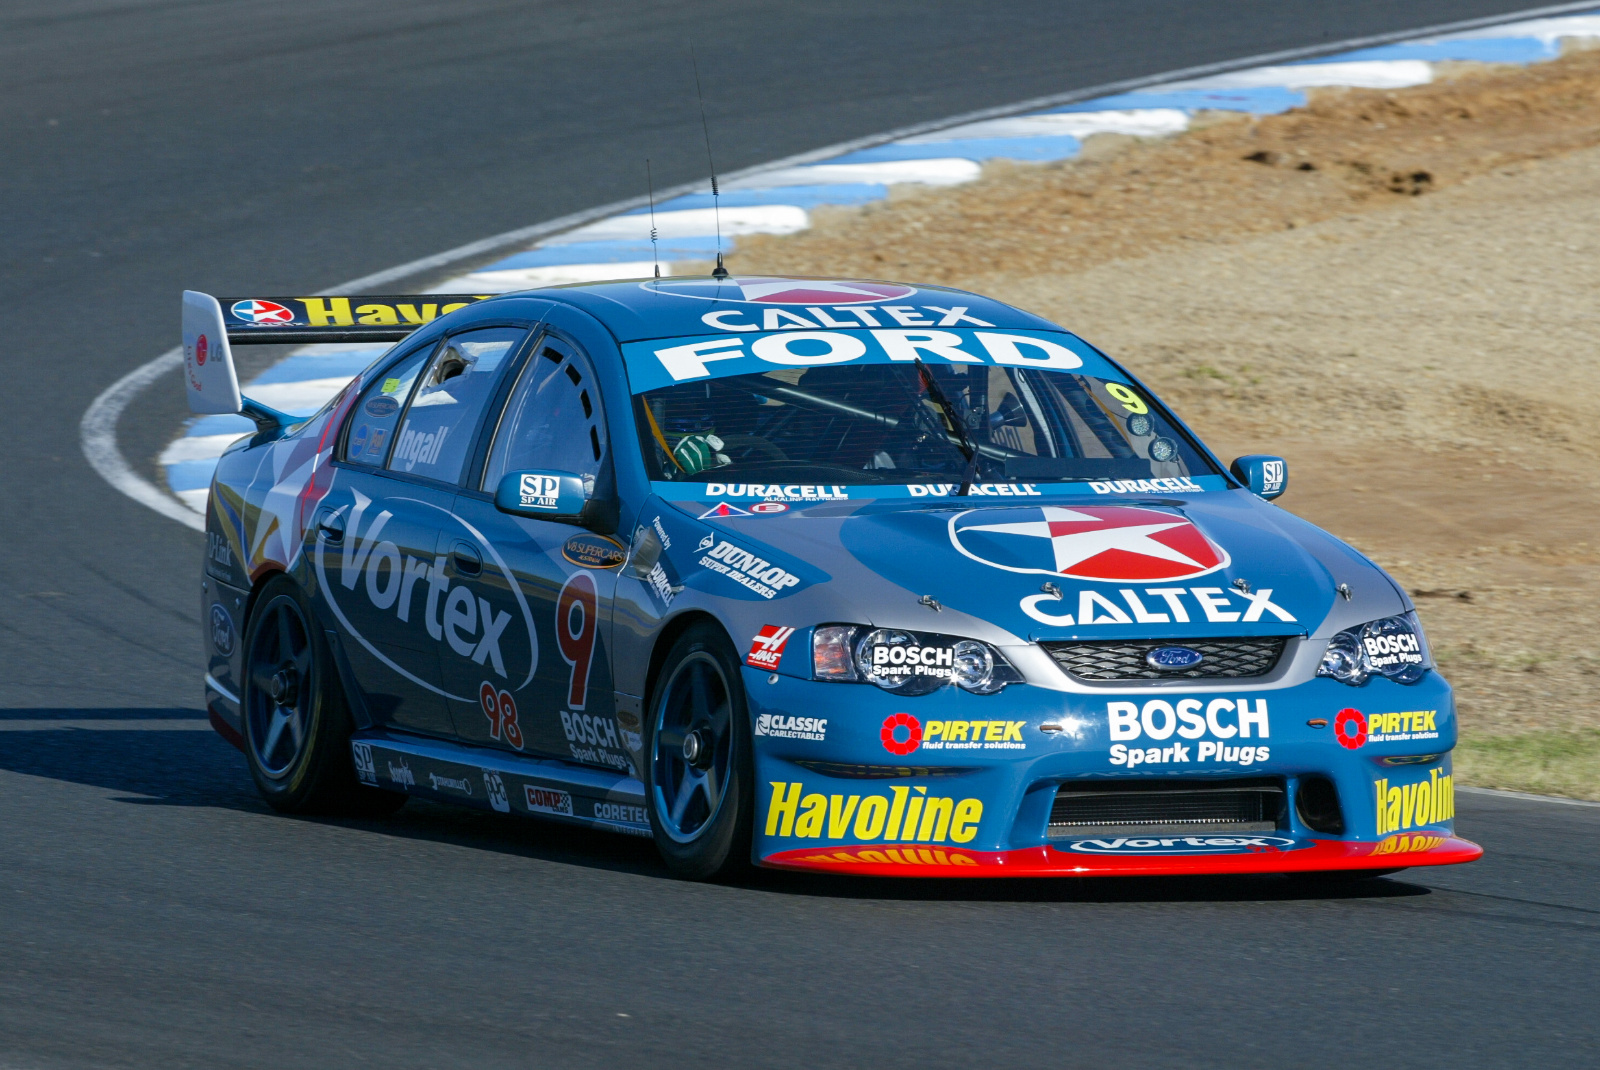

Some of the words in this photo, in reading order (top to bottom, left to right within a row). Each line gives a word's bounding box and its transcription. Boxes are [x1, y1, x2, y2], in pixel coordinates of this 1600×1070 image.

[701, 305, 996, 331] CALTEX
[653, 329, 1083, 381] FORD
[1105, 383, 1148, 414] 9
[394, 419, 449, 472] Ingall
[1265, 463, 1282, 482] SP
[521, 476, 557, 496] SP
[705, 483, 849, 498] DURACELL
[1088, 477, 1200, 495] DURACELL
[521, 496, 535, 504] SP
[537, 497, 556, 506] AIR
[652, 515, 669, 541] Powered
[567, 541, 577, 552] V8
[576, 542, 626, 562] SUPERCARS
[707, 540, 801, 590] DUNLOP
[341, 486, 512, 679] Vortex
[650, 561, 676, 608] DURACELL
[699, 556, 732, 575] SUPER
[727, 569, 777, 600] DEALERS
[1019, 587, 1298, 627] CALTEX
[555, 569, 598, 710] 9
[1363, 633, 1420, 656] BOSCH
[750, 648, 782, 663] HAAS
[873, 646, 953, 666] BOSCH
[1159, 649, 1191, 665] Ford
[1369, 654, 1399, 668] Spark
[1398, 652, 1422, 664] Plugs
[872, 665, 912, 677] Spark
[914, 665, 952, 678] Plugs
[479, 679, 524, 751] 98
[769, 715, 828, 734] CLASSIC
[1106, 698, 1270, 741] BOSCH
[1367, 710, 1437, 735] PIRTEK
[559, 710, 620, 749] BOSCH
[769, 729, 826, 742] CARLECTABLES
[922, 720, 1027, 742] PIRTEK
[1368, 734, 1384, 743] fluid
[1385, 733, 1411, 742] transfer
[1411, 731, 1439, 740] solutions
[569, 742, 598, 763] Spark
[599, 748, 627, 769] Plugs
[922, 741, 944, 749] fluid
[945, 741, 983, 749] transfer
[983, 741, 1027, 750] solutions
[1108, 742, 1190, 768] Spark
[1197, 741, 1271, 766] Plugs
[526, 787, 562, 808] COMP
[764, 781, 984, 844] Havoline
[1083, 837, 1271, 849] Vortex
